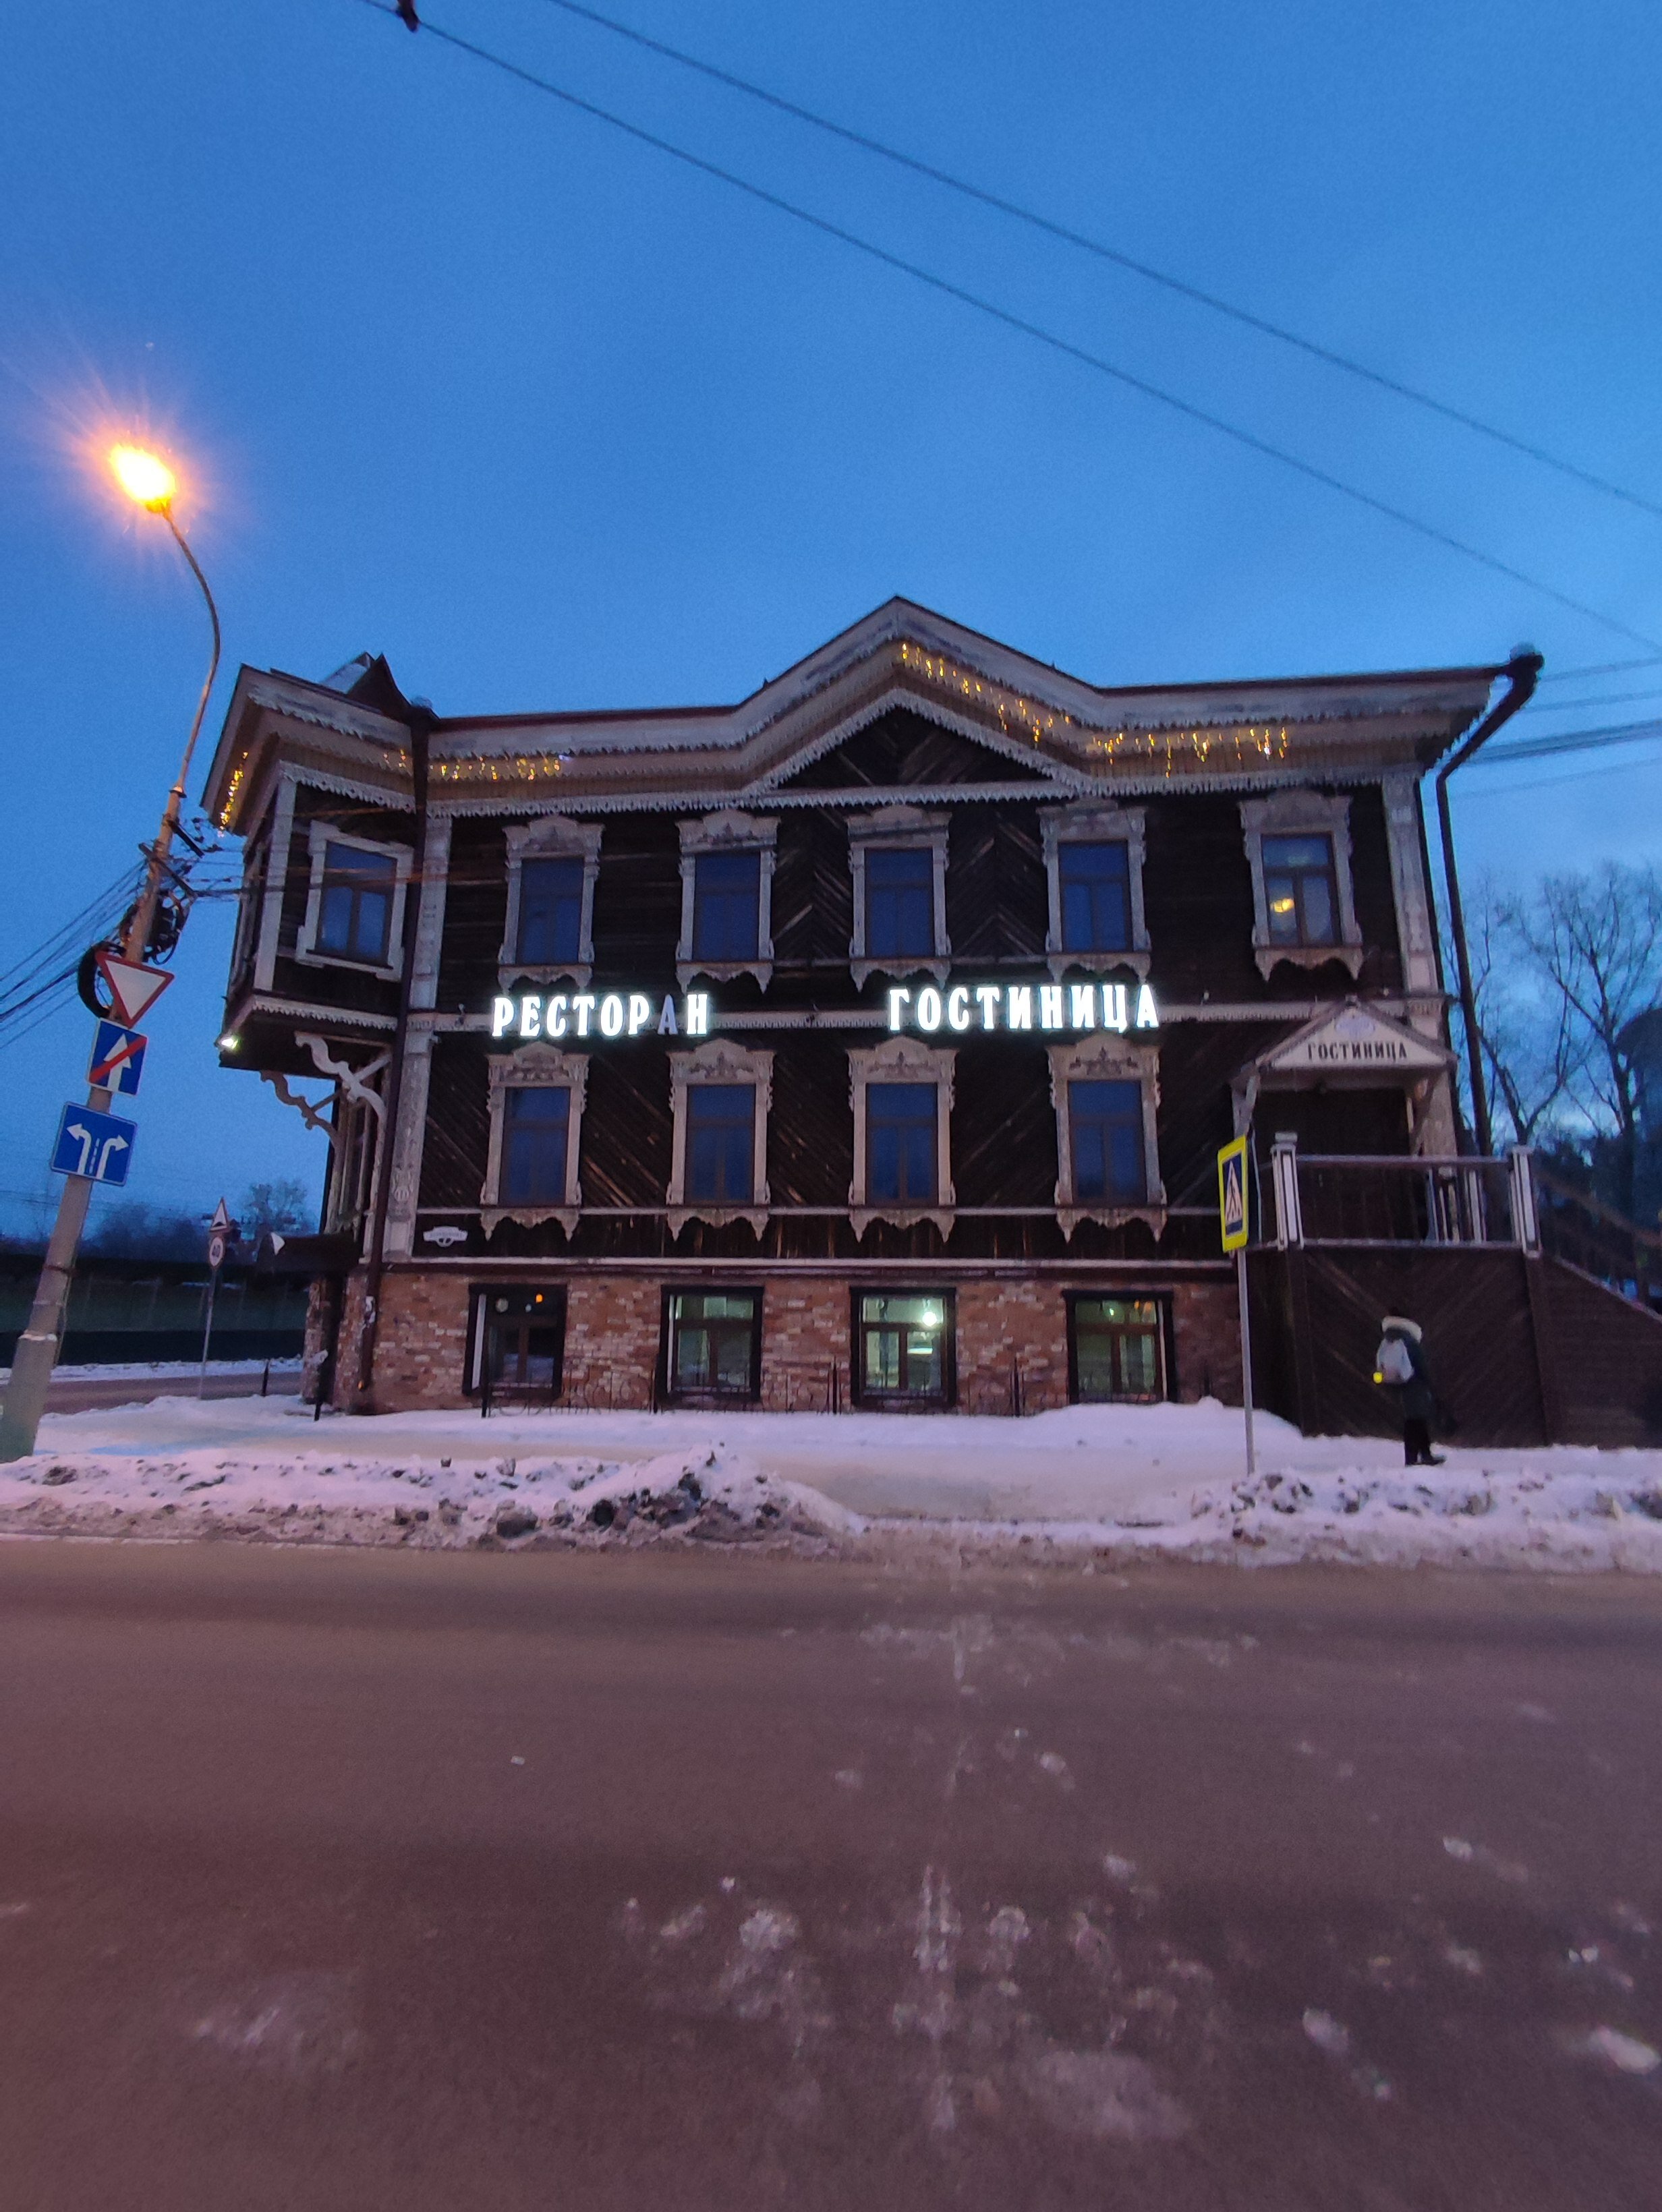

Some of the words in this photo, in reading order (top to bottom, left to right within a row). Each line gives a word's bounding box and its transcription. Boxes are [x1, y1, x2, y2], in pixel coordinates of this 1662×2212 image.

[491, 994, 708, 1037] РЕСТОРАН
[889, 984, 1159, 1034] ГОСТИНИЦА
[1307, 1042, 1408, 1063] ГОСТИНИЦА
